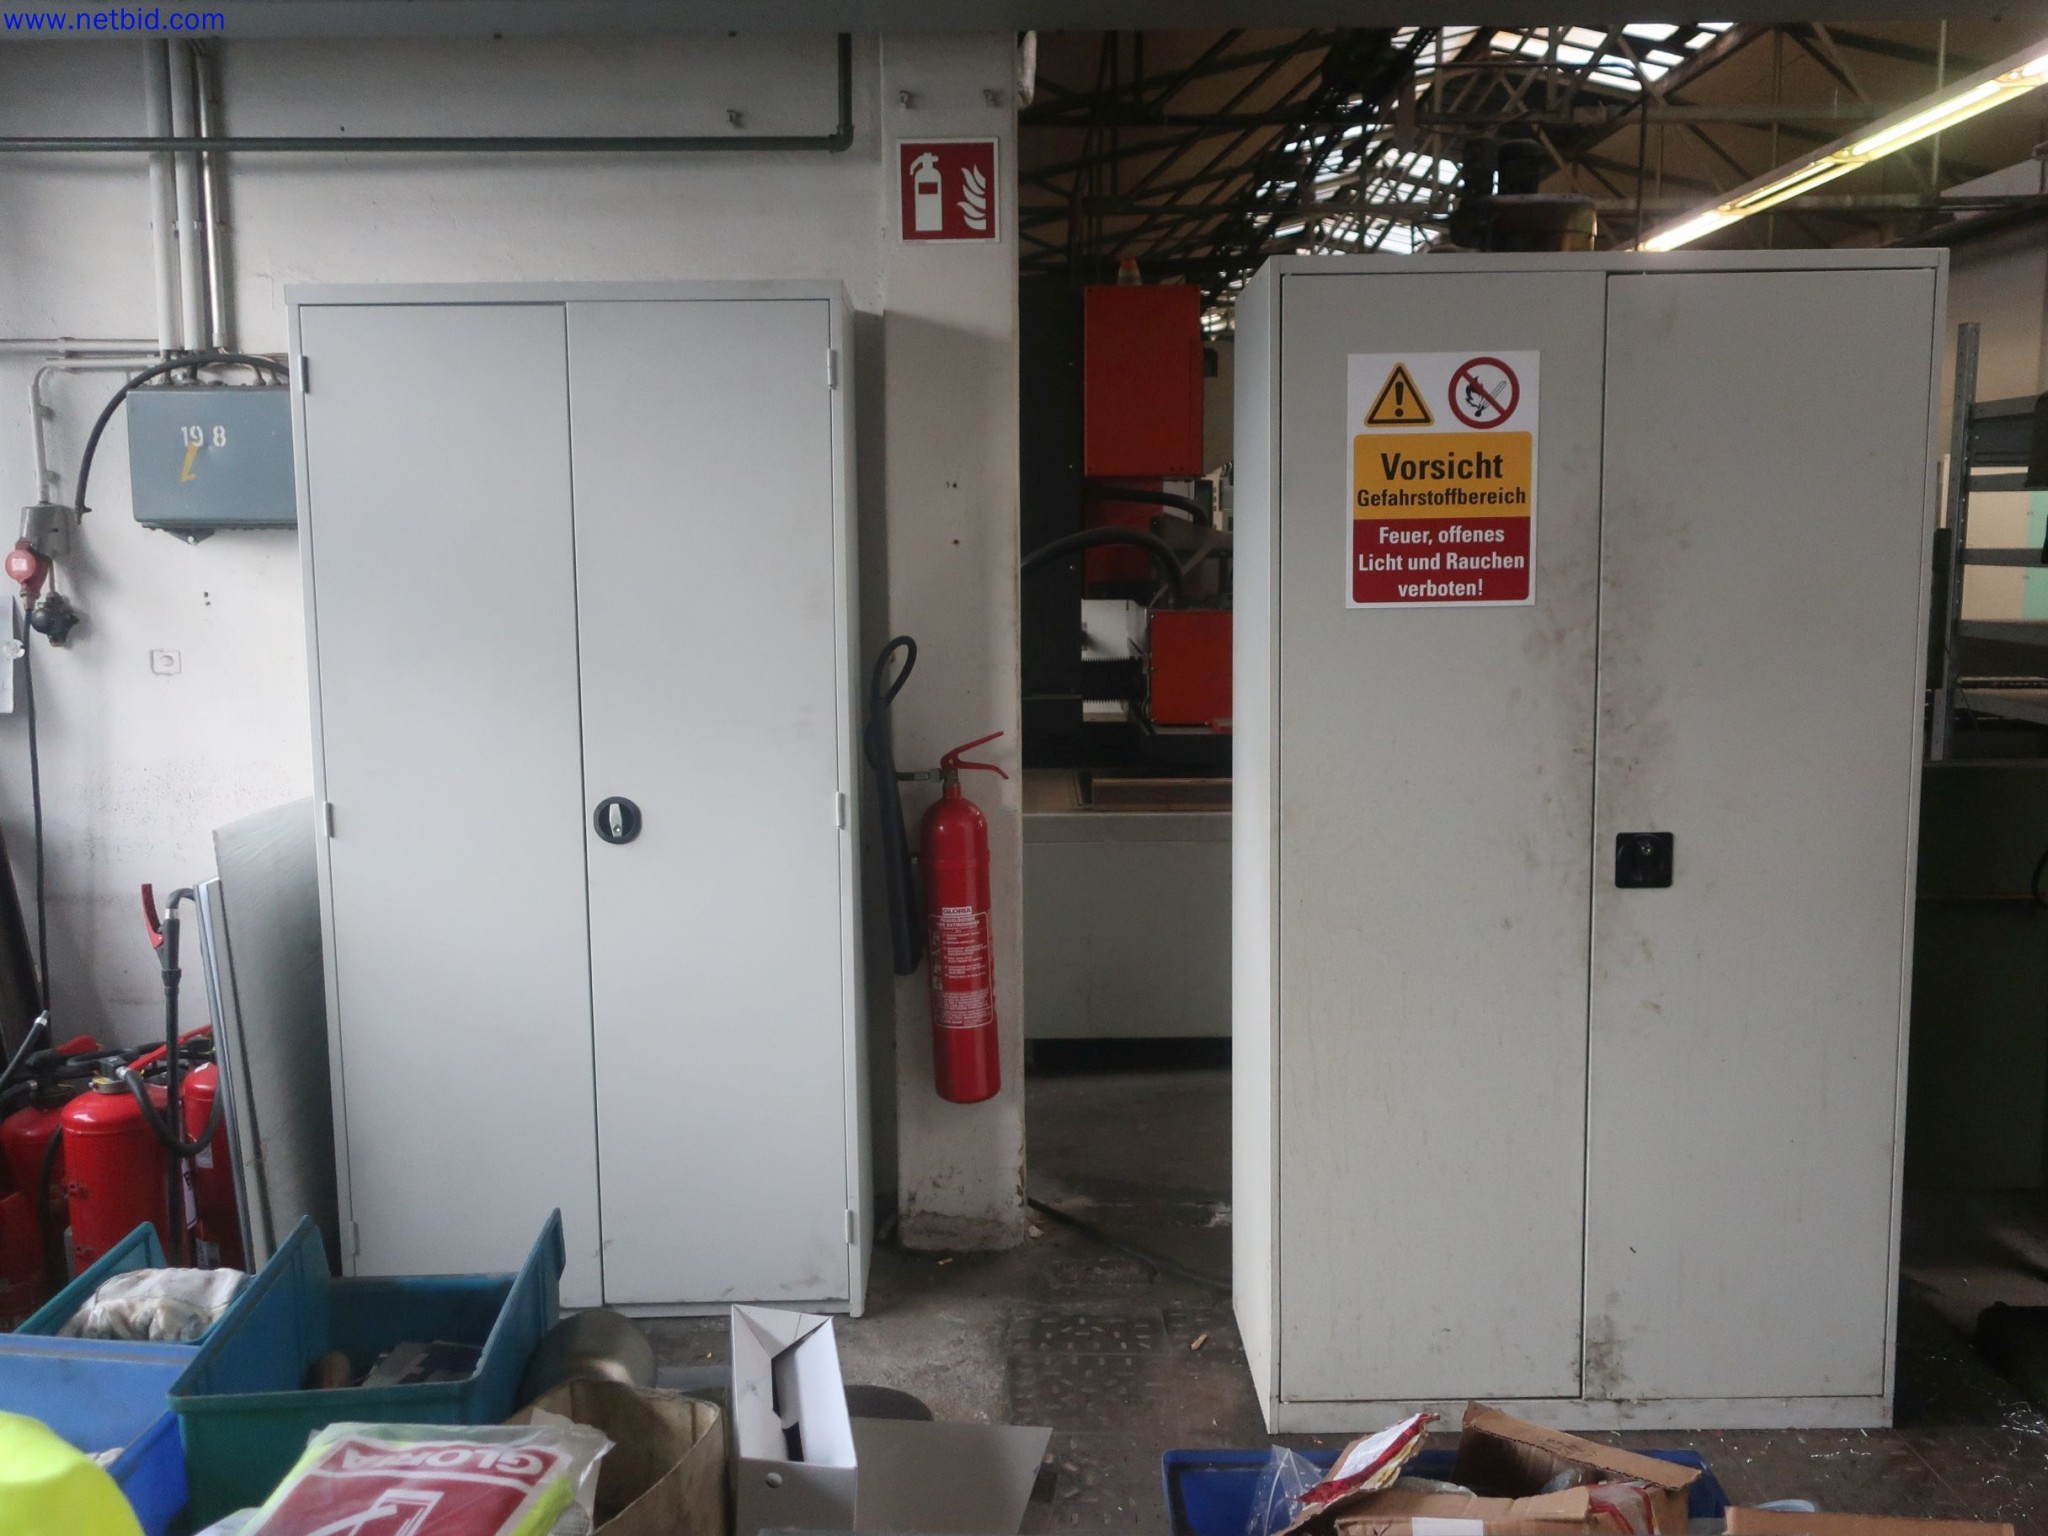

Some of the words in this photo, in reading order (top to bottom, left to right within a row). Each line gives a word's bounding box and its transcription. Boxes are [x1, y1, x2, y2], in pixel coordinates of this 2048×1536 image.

[1381, 452, 1503, 480] Vorsicht
[1357, 487, 1526, 507] Gefahrstoffbereich
[1379, 526, 1433, 545] Feuer,
[1438, 525, 1505, 543] offenes
[1358, 553, 1403, 571] Licht
[1408, 552, 1440, 570] und
[1446, 551, 1525, 570] Rauchen
[1398, 578, 1483, 597] verboten!
[342, 1448, 544, 1475] GLORA
